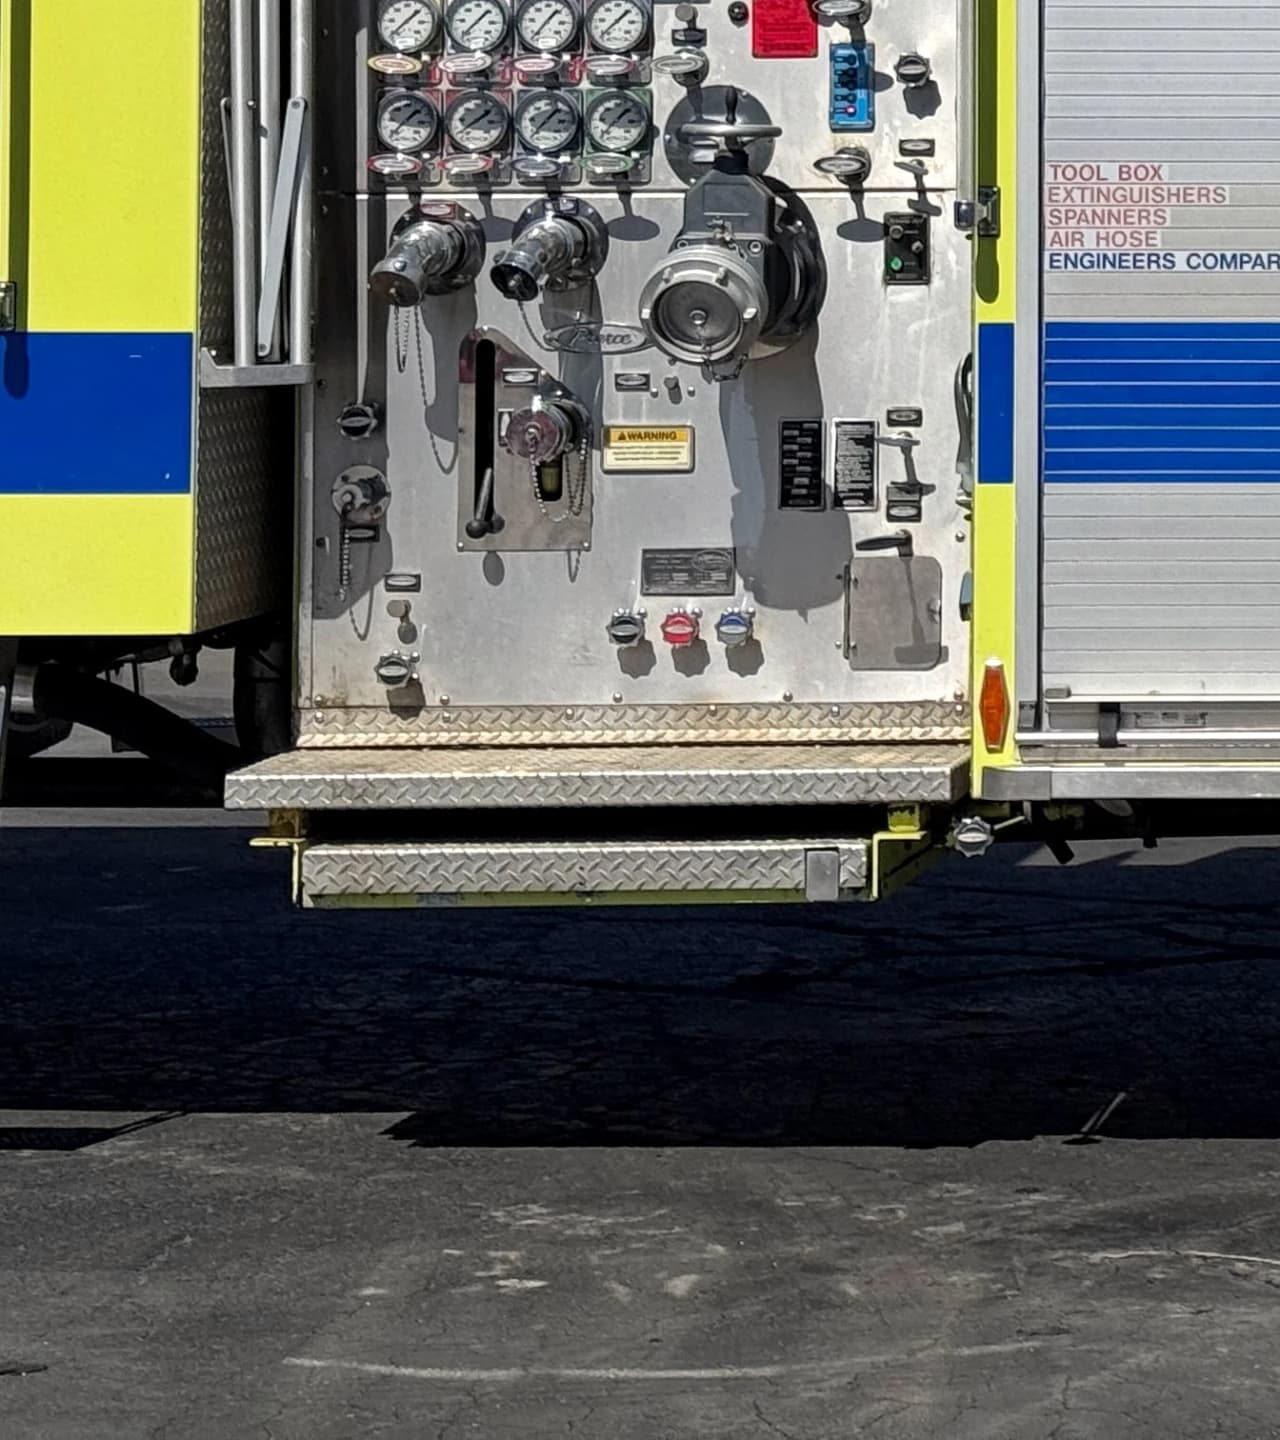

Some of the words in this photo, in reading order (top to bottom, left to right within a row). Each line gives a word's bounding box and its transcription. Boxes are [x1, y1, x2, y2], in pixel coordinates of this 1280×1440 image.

[1049, 165, 1109, 181] TOOL
[1118, 165, 1164, 181] BOX
[1047, 186, 1228, 204] EXTINGUISHERS
[1047, 208, 1168, 226] SPANNERS
[1048, 230, 1085, 248] AIR
[1095, 230, 1160, 248] HOSE
[1048, 252, 1177, 271] ENGINEERS
[627, 431, 678, 441] WARNING
